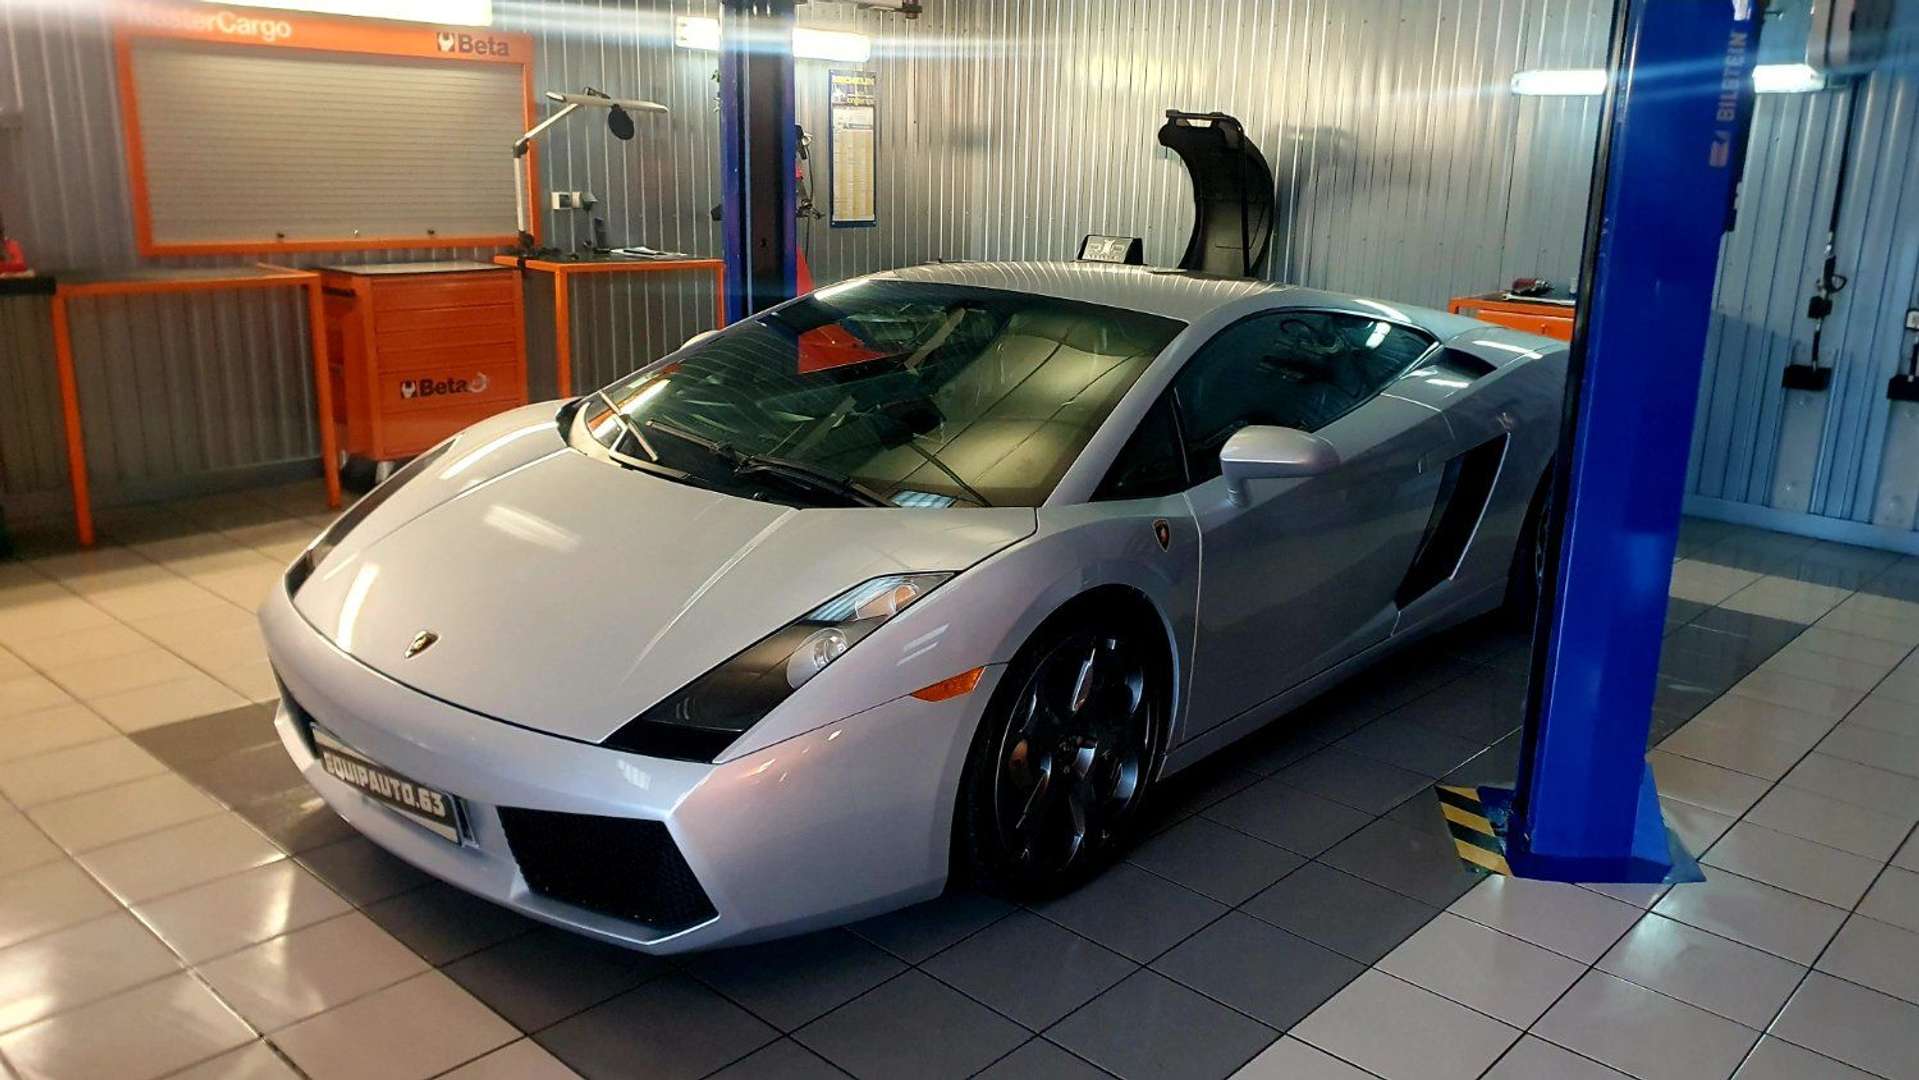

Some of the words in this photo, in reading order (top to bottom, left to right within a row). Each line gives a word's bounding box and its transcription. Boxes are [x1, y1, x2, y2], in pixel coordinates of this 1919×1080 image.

[127, 4, 293, 42] asterCargo
[458, 33, 510, 56] Beta
[1716, 31, 1748, 121] BILSTEIN
[419, 378, 468, 397] Beta
[323, 751, 446, 817] EQUIPAUTO.63
